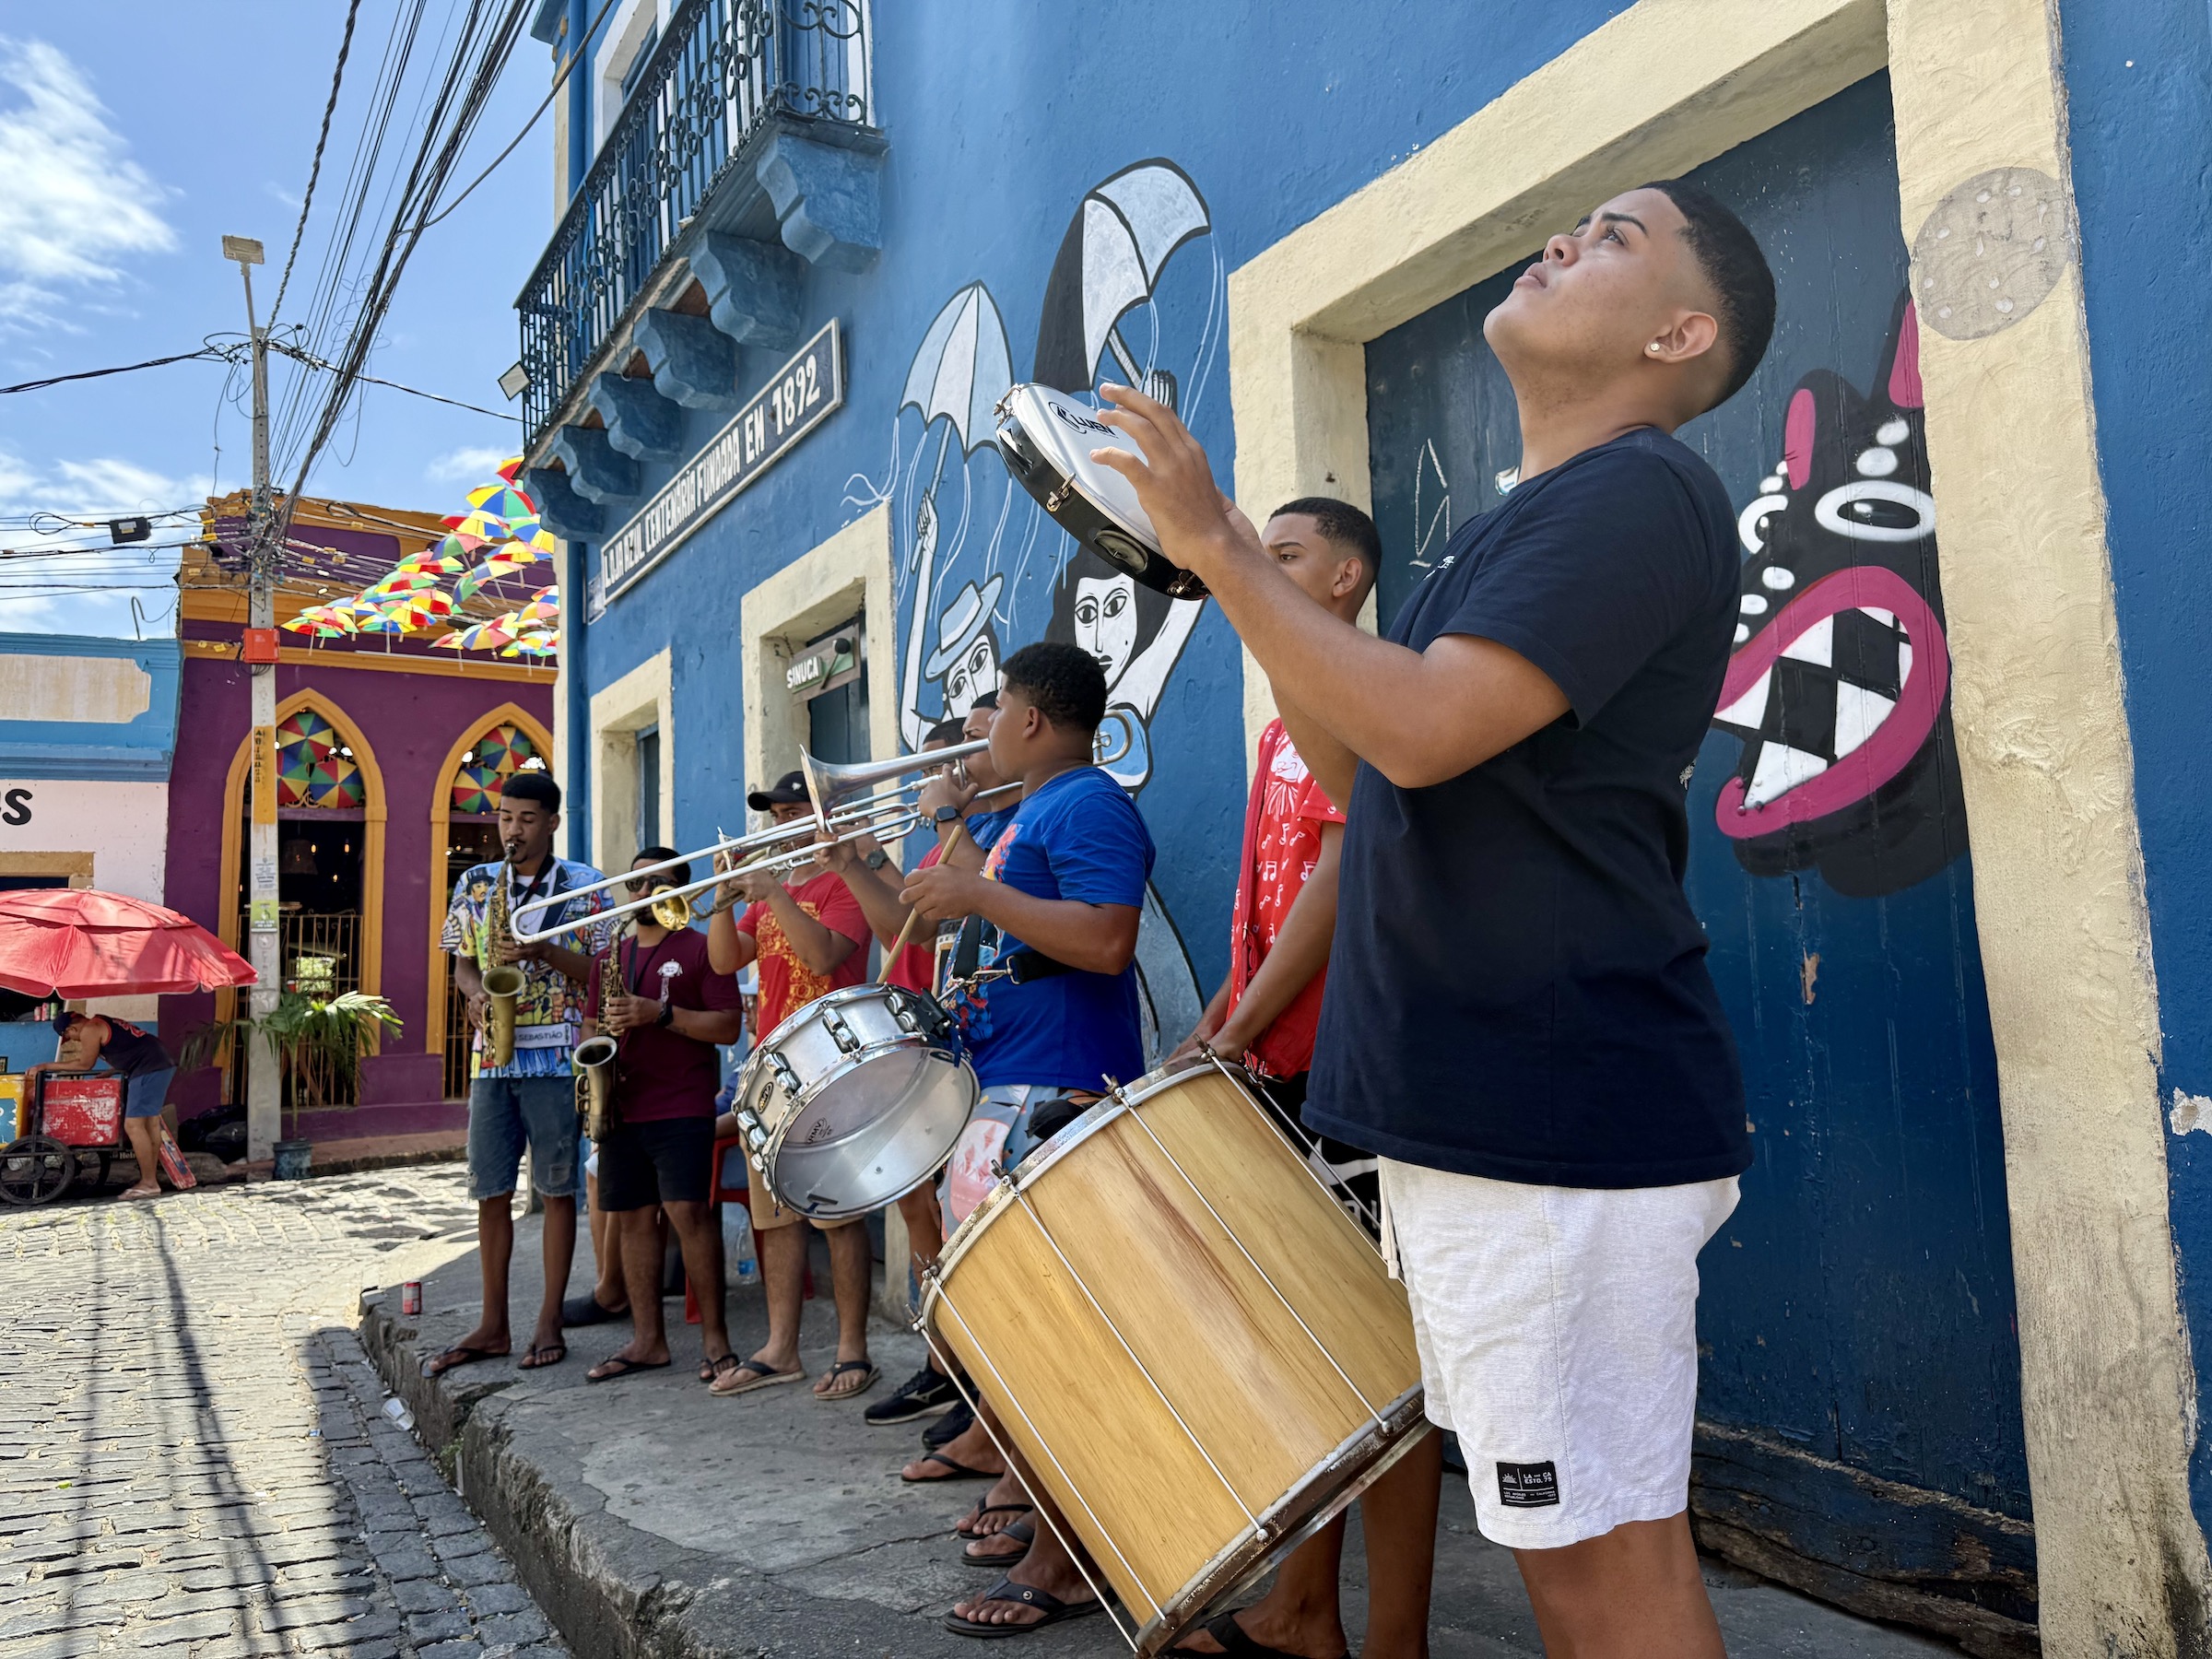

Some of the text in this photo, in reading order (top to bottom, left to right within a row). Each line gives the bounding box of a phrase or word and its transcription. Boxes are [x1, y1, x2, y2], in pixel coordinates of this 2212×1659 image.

[604, 540, 625, 588] LOJA
[623, 523, 645, 572] AZUL
[697, 426, 740, 508] FUNDADA
[745, 404, 765, 465] EM
[772, 354, 821, 436] 1892
[786, 655, 820, 689] SINUCA
[518, 1030, 563, 1041] SEBASTIÃO
